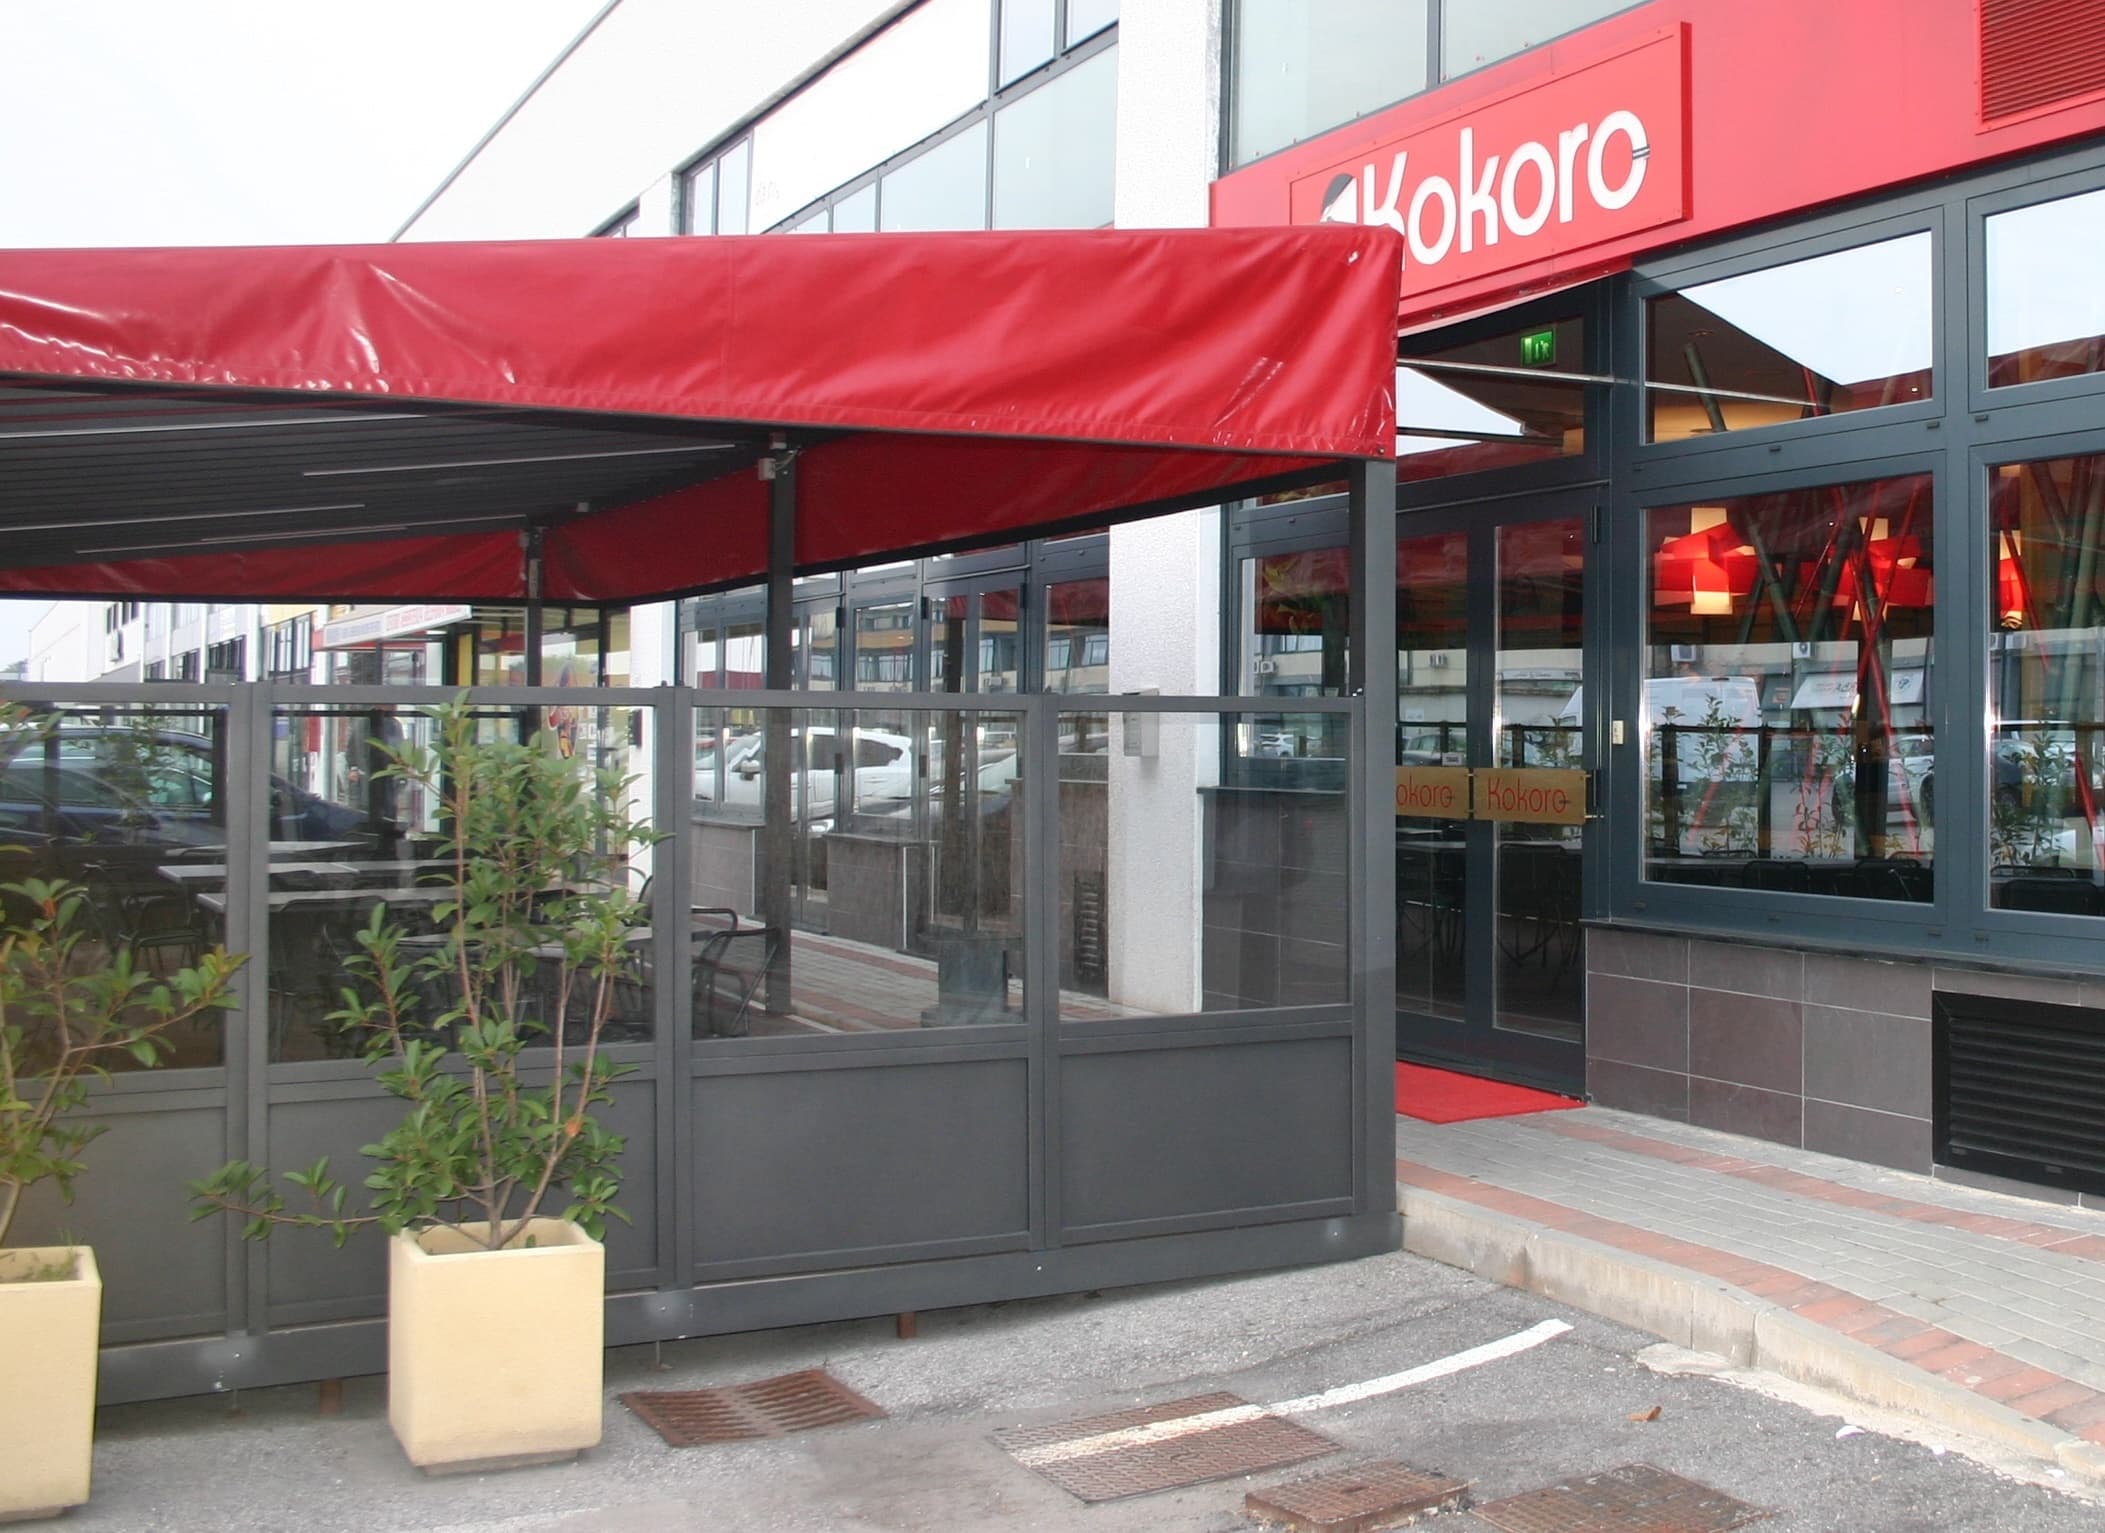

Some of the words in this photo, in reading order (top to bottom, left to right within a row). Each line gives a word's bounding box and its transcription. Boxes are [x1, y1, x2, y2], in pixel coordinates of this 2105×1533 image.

[1363, 110, 1649, 271] Kokoro
[1396, 775, 1454, 808] okoro
[1487, 777, 1568, 814] Kokoro
